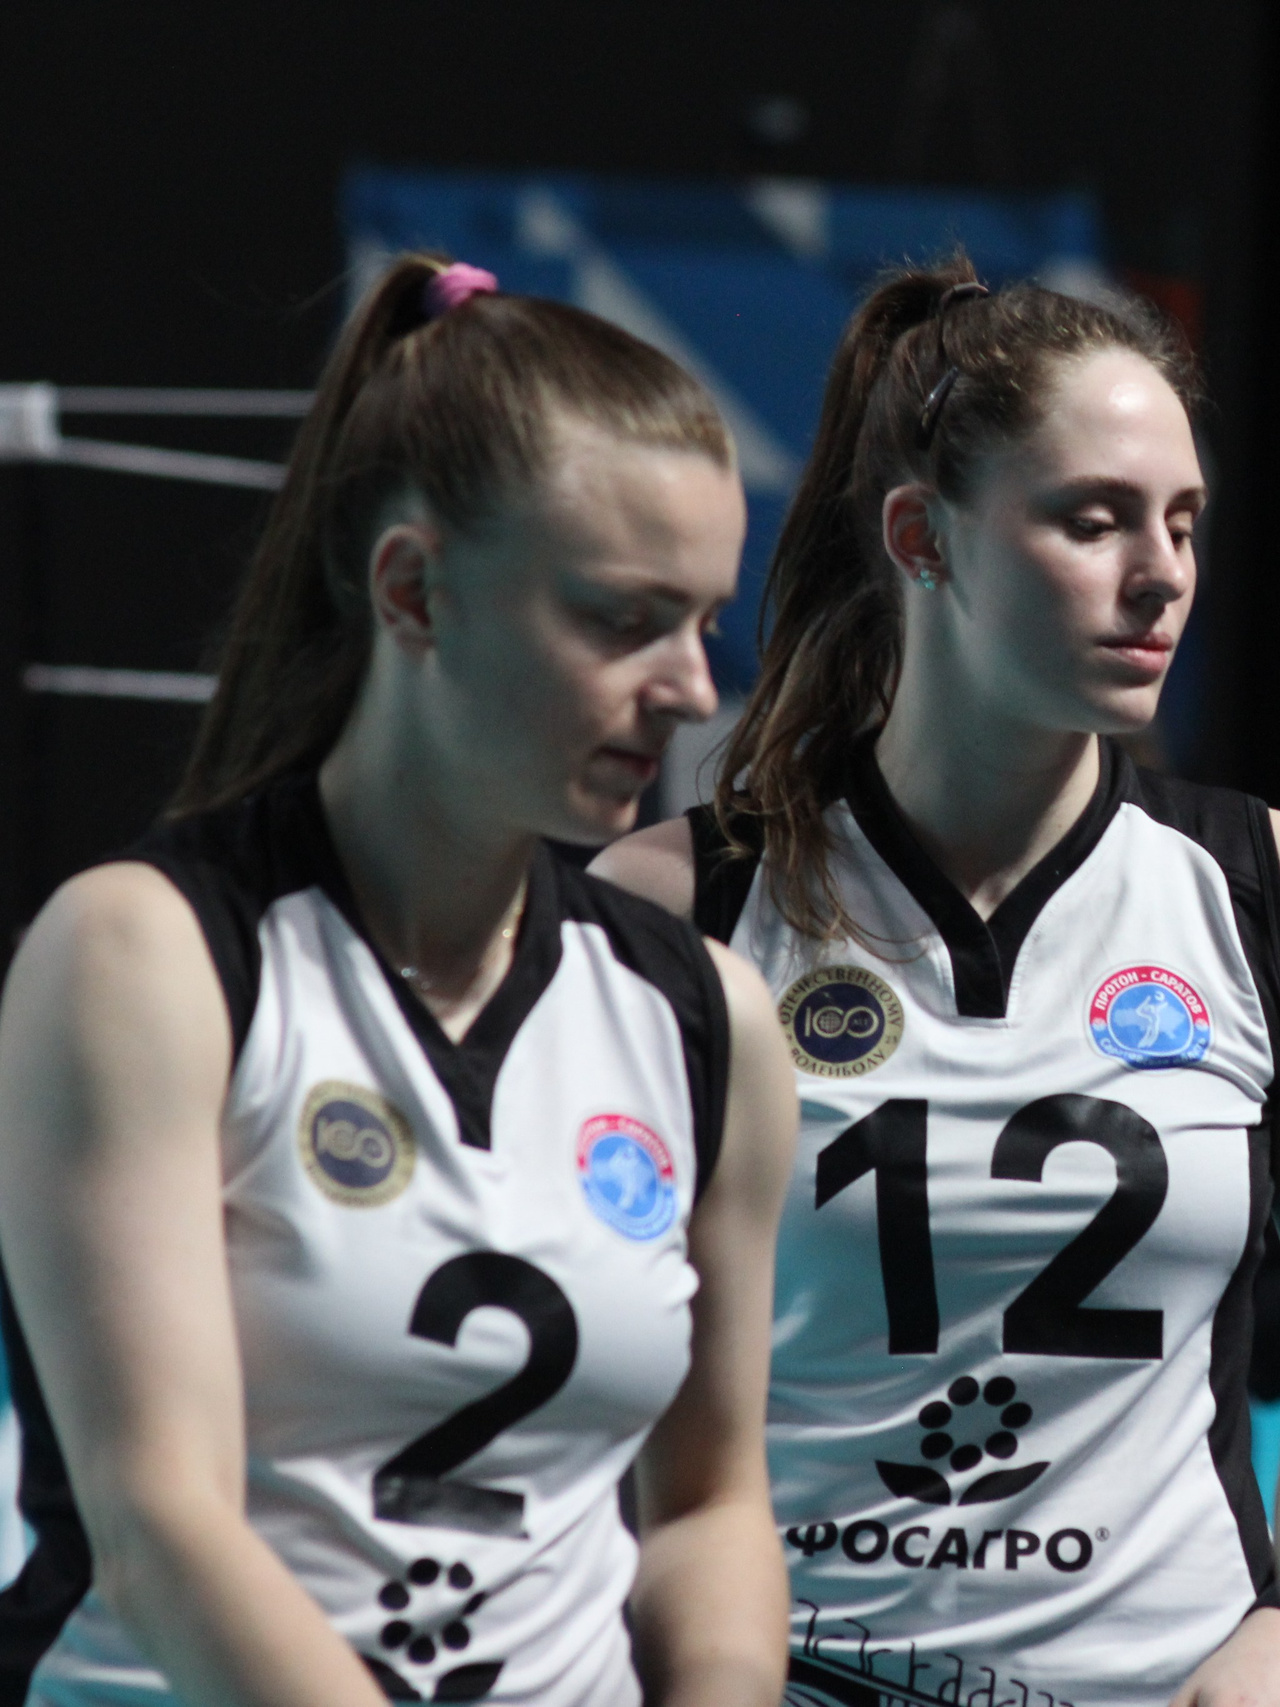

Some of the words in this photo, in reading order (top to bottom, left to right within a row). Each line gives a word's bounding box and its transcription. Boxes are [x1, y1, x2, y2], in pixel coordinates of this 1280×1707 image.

[1094, 971, 1139, 1011] ПРОТОН
[1150, 970, 1203, 1014] САРАТОВ
[815, 1092, 1169, 1360] 12
[372, 1250, 580, 1540] 2
